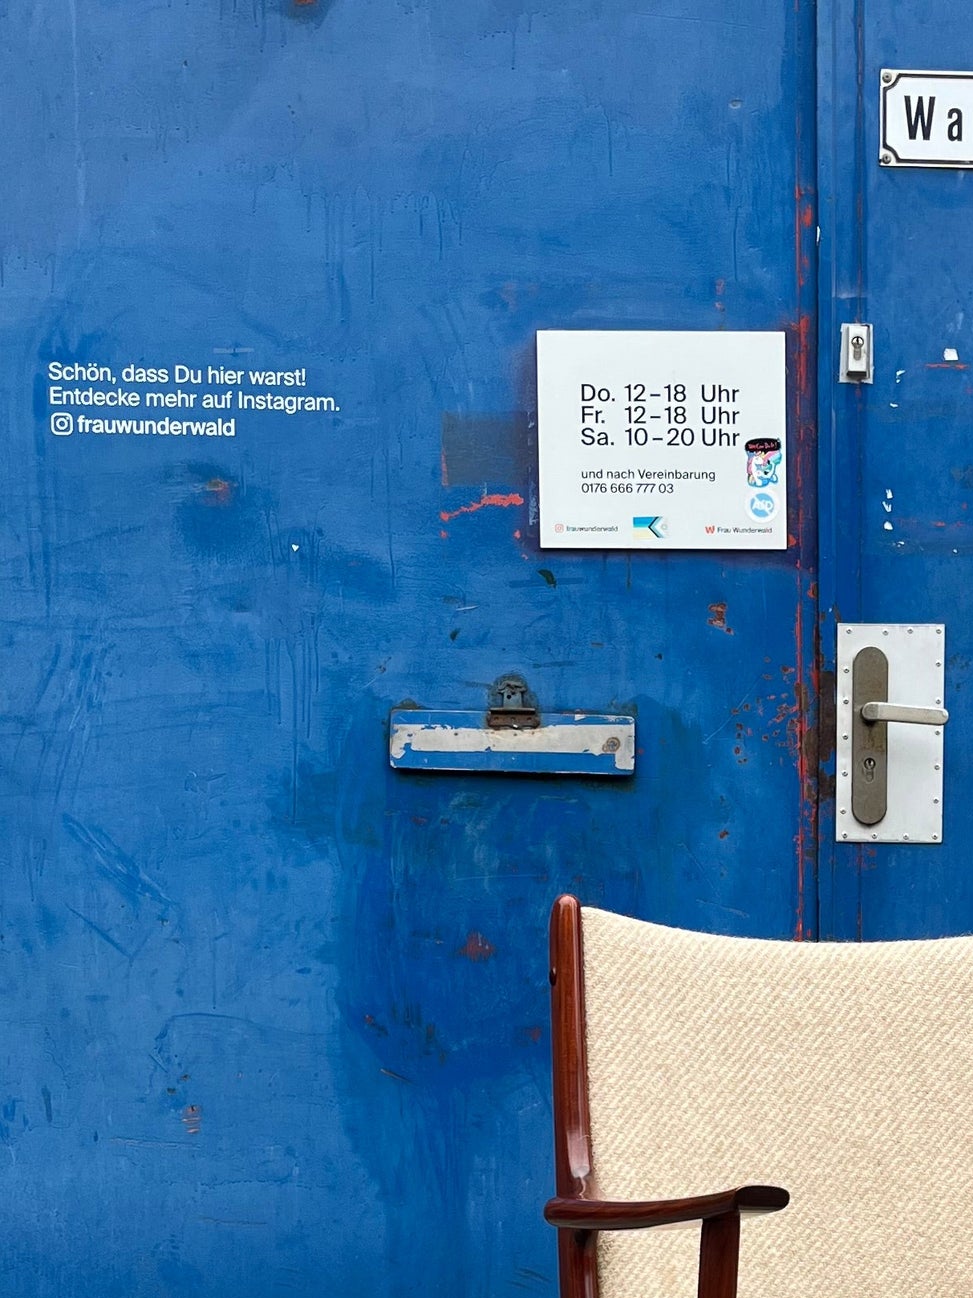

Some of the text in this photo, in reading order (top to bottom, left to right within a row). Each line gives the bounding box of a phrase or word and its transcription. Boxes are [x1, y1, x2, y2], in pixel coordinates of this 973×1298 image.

[48, 361, 307, 387] Schön, dass Du hier warst!
[49, 386, 341, 415] Entdecke mehr auf Instagram.
[580, 383, 616, 402] Do.
[701, 384, 740, 403] Uhr
[580, 405, 606, 424] Fr.
[701, 406, 740, 425] Uhr
[76, 414, 236, 437] frauwunderwald
[580, 427, 615, 446] Sa.
[701, 427, 741, 447] Uhr
[580, 468, 716, 482] und nach Vereinbarung
[580, 482, 675, 494] 0176 666 777 03
